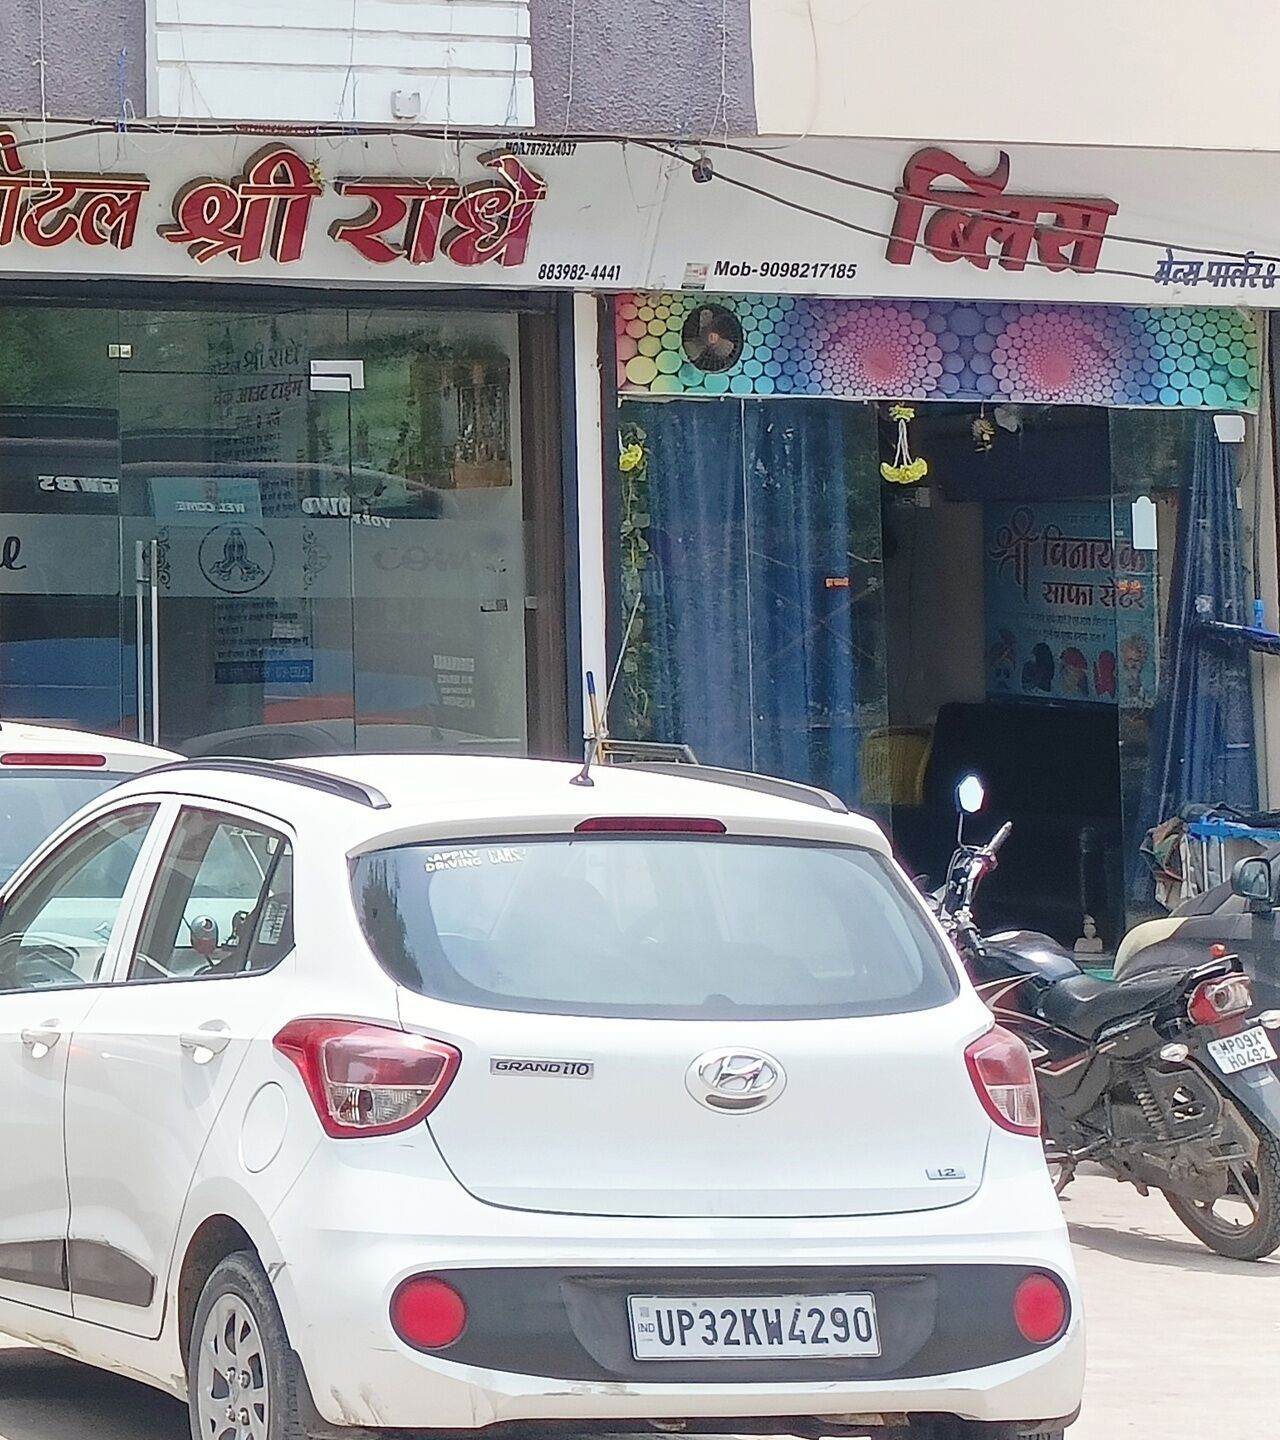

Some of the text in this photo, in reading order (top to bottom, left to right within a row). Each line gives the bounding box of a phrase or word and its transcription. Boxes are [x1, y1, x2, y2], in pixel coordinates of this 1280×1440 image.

[158, 142, 323, 266] श्री
[330, 147, 548, 269] राधे
[884, 146, 1119, 274] ब्लिस
[538, 264, 621, 281] 883982-4441
[713, 260, 858, 279] Mob-9098217185
[495, 1061, 590, 1076] GRAND i10
[637, 1306, 874, 1347] IND UP32KW4290
